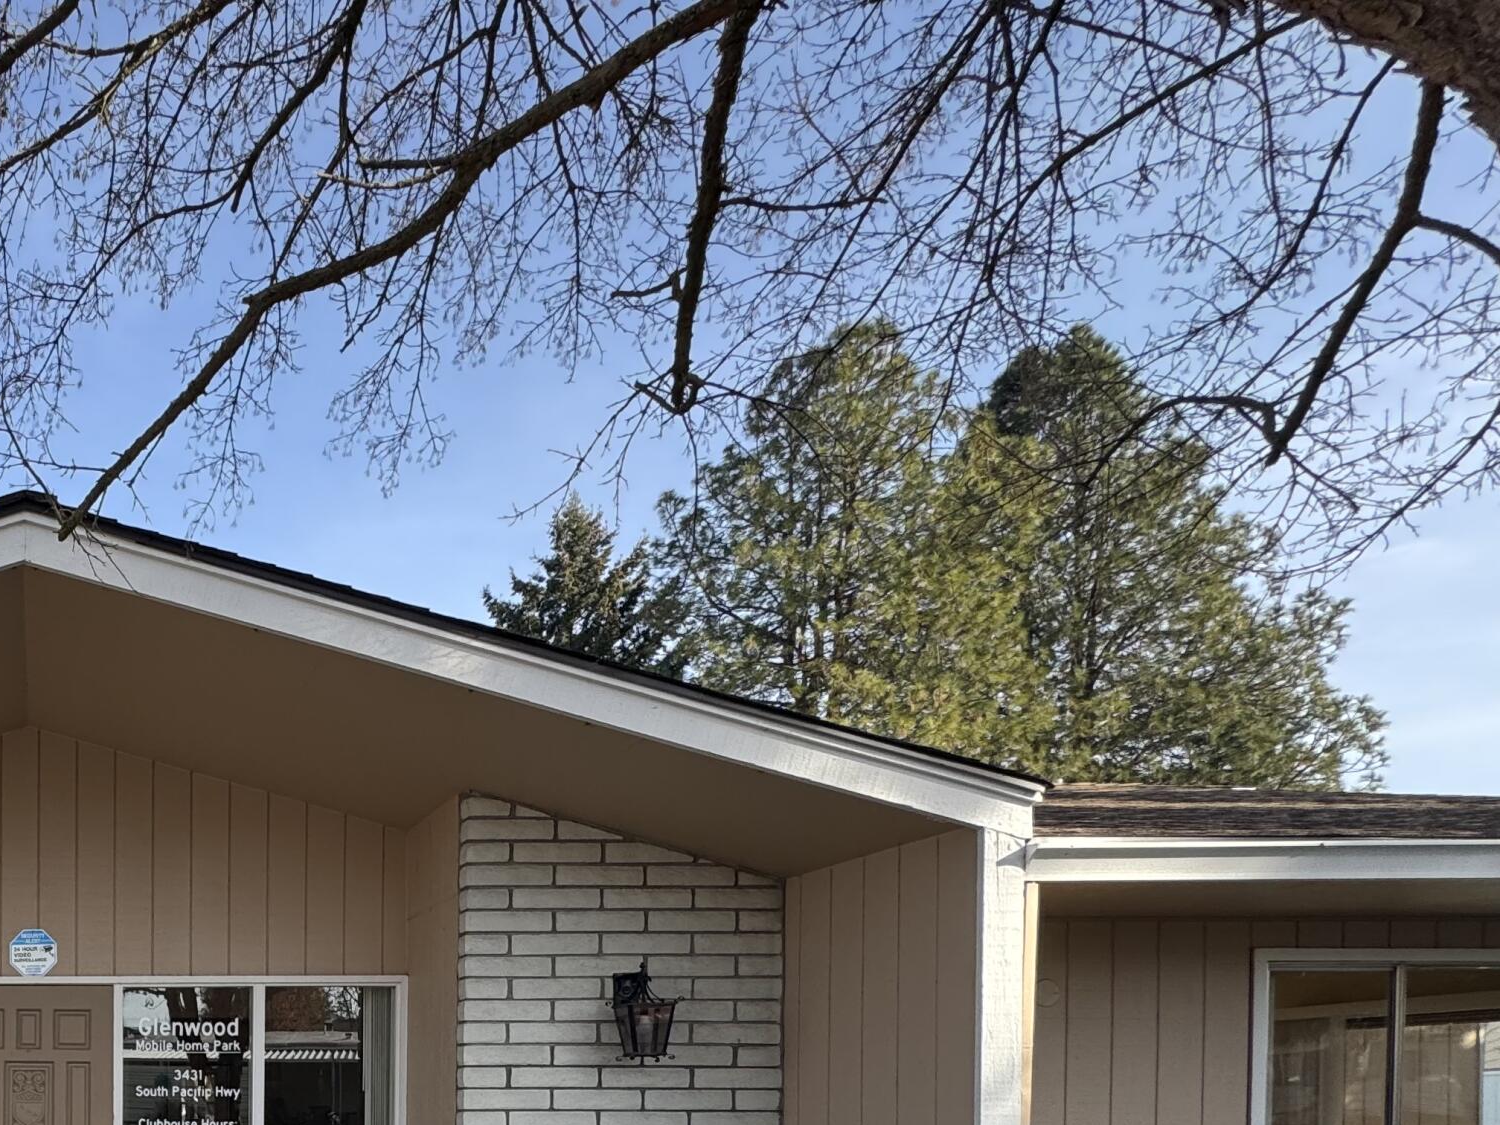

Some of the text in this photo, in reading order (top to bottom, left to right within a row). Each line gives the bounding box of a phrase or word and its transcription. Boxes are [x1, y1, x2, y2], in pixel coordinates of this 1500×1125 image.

[138, 1017, 239, 1037] Glenwood
[135, 1039, 241, 1052] Mobile Home Park
[173, 1069, 203, 1081] 3431
[135, 1085, 241, 1101] South Pacific Hwy
